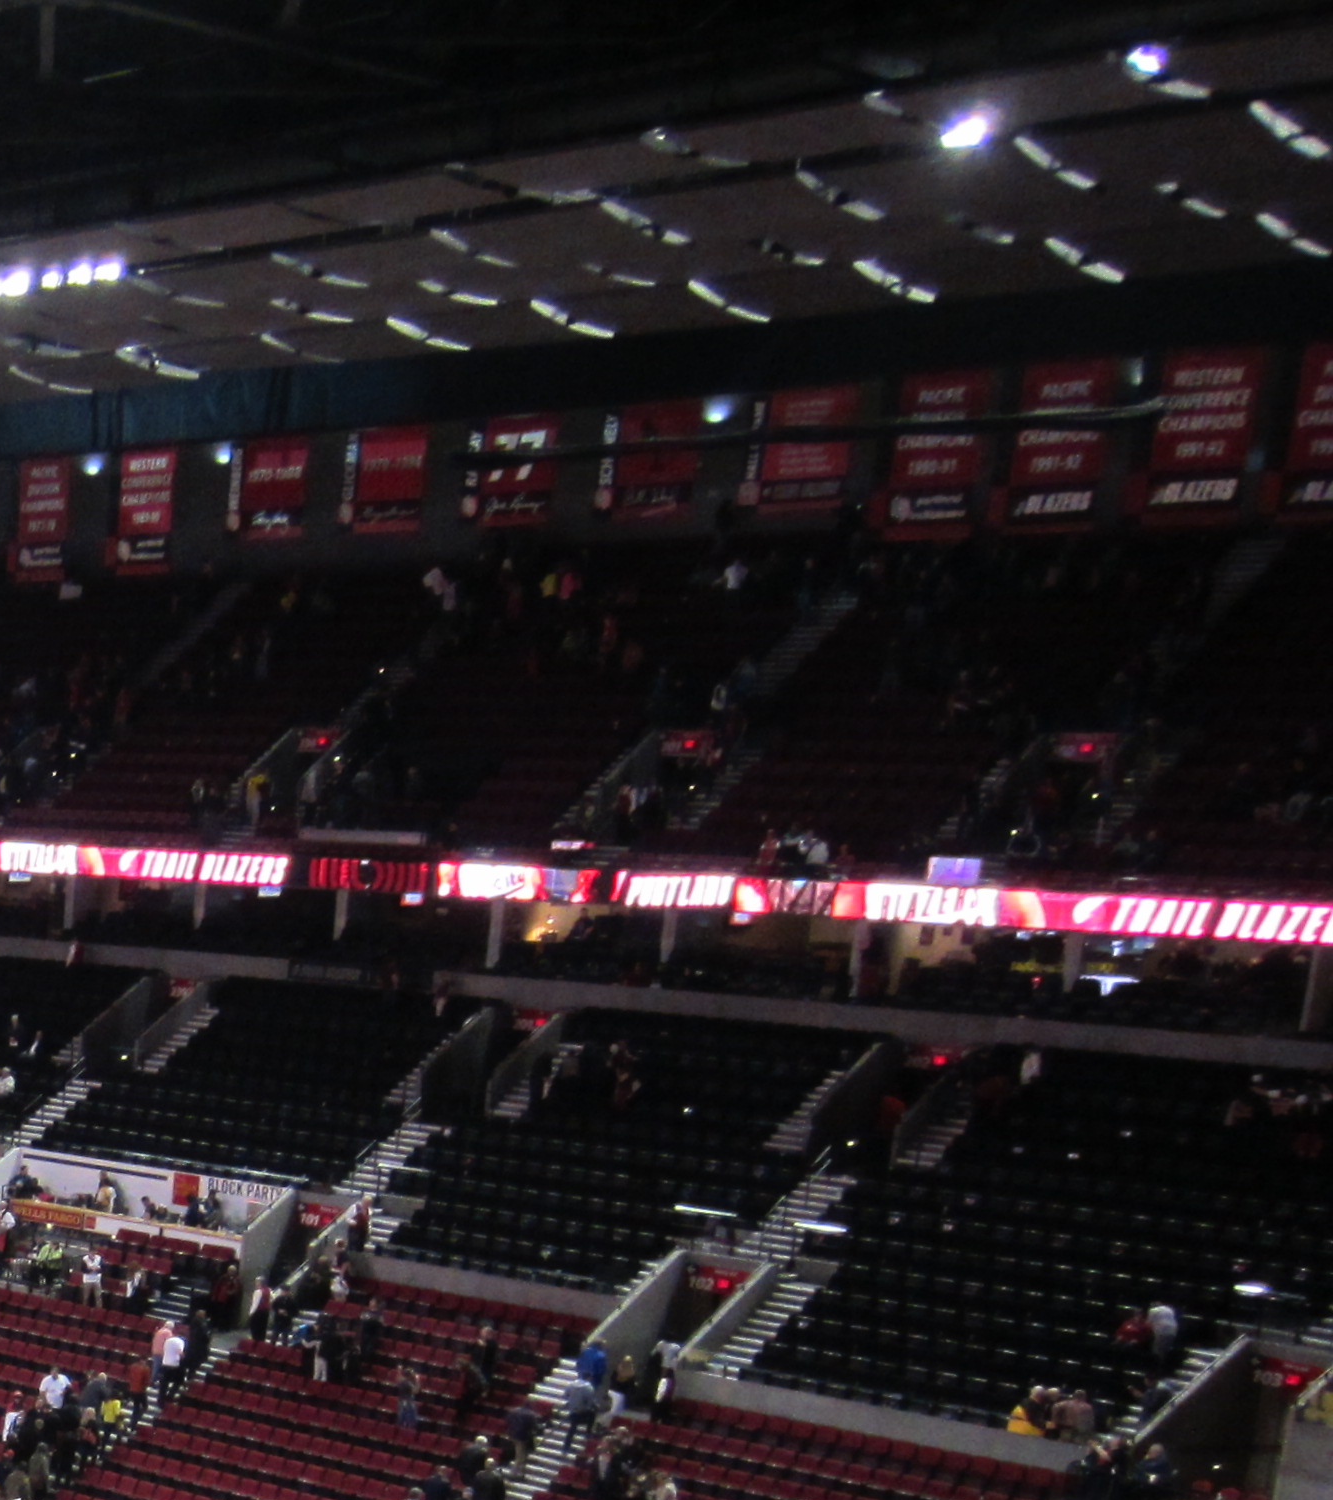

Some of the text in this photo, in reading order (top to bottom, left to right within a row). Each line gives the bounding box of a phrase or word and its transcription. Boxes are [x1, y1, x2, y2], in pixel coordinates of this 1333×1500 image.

[1173, 366, 1246, 386] WESTERN
[1158, 412, 1247, 433] CHAMPIONS
[1023, 490, 1093, 515] BLAZERS
[1163, 478, 1238, 503] BLAZERS
[141, 849, 289, 885] TRAIL BLAZERS
[626, 875, 734, 906] PORTLAND
[1112, 897, 1333, 944] TRAIL BLAZE
[208, 1177, 283, 1200] BLOCK PARTY
[13, 1205, 80, 1225] WELLS FARGO
[300, 1212, 320, 1226] 101
